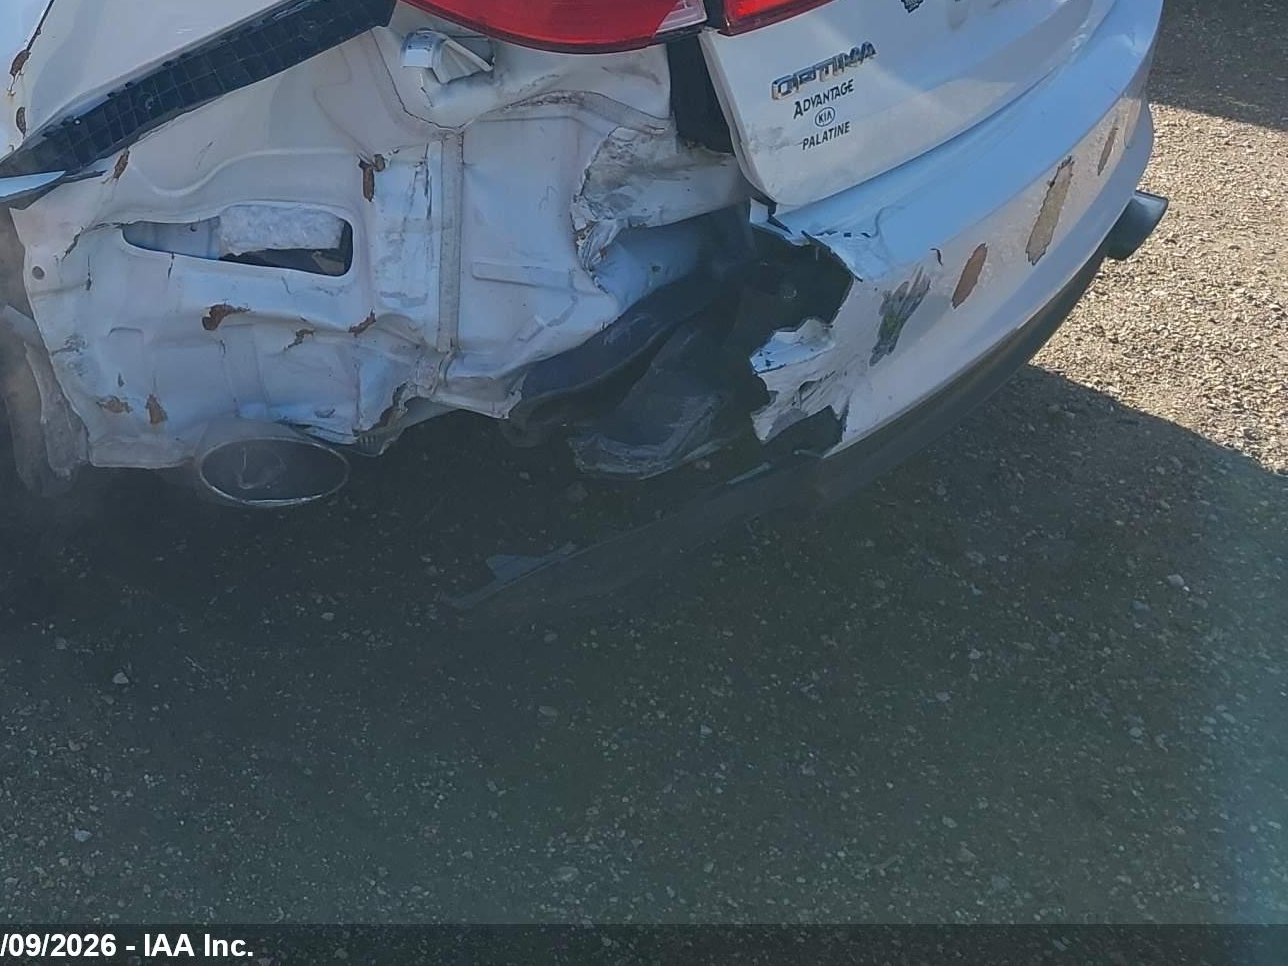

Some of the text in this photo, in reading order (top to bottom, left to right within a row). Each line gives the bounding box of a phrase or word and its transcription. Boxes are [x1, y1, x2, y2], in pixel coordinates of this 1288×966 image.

[771, 41, 877, 101] OPTIMA
[817, 109, 834, 125] KIA
[802, 121, 851, 151] PALATINE
